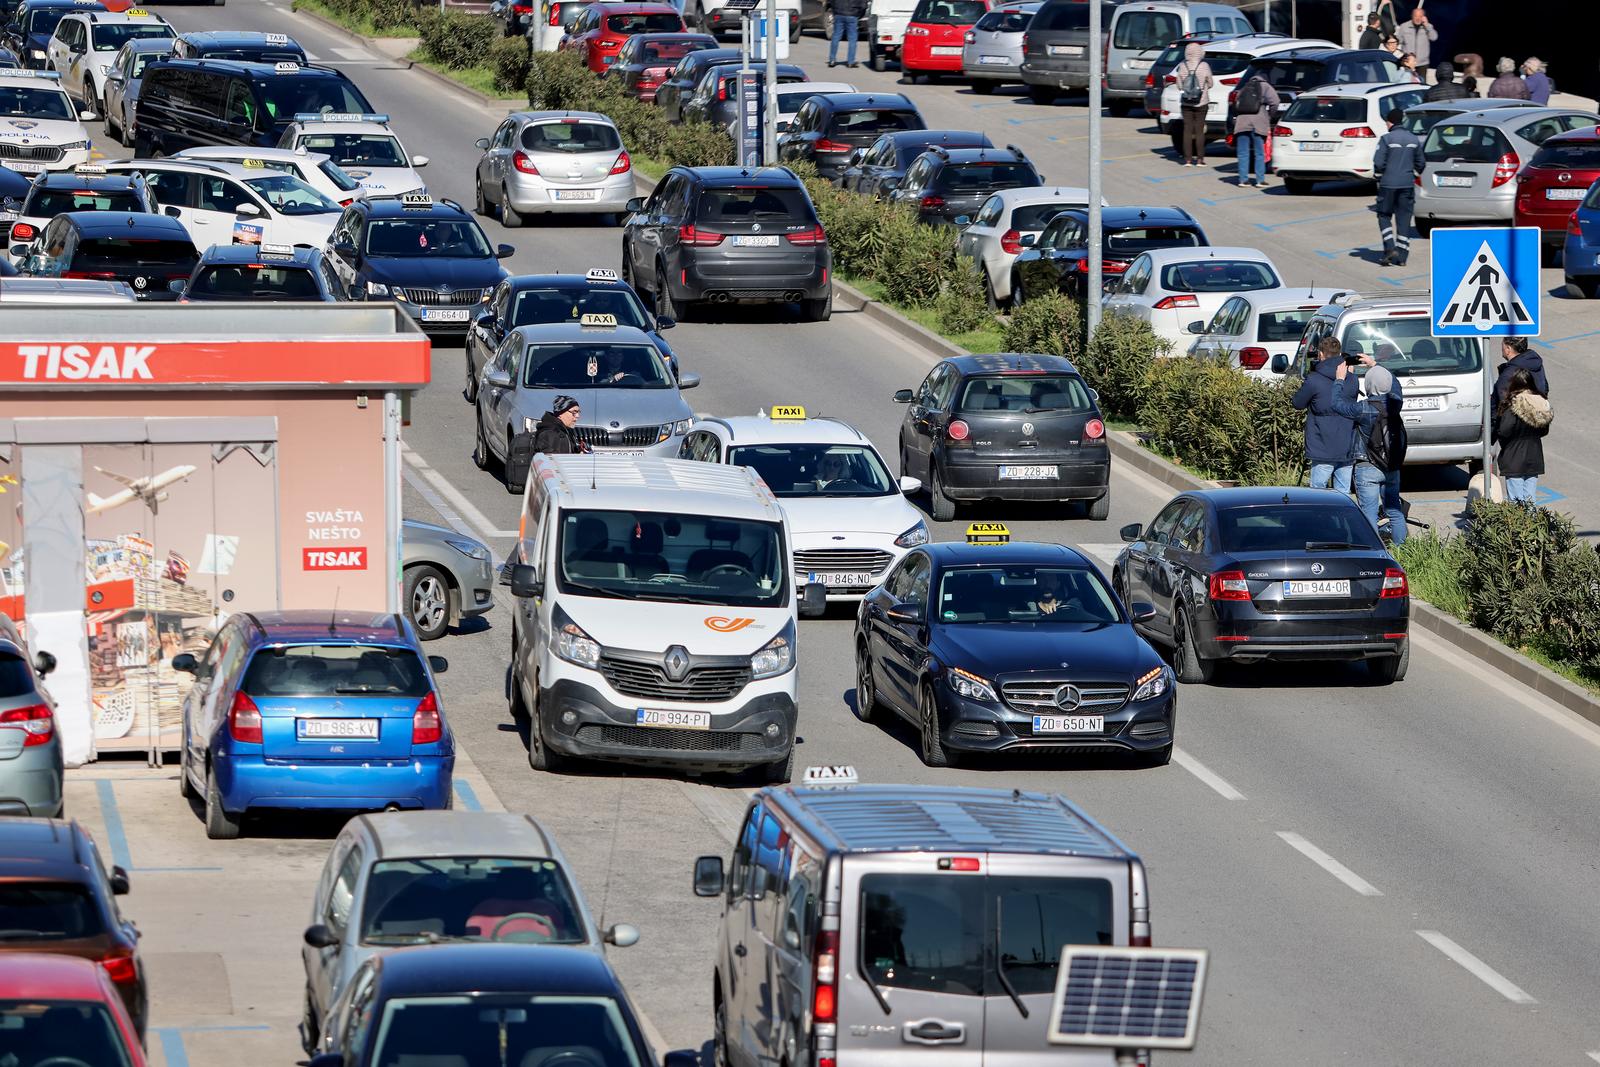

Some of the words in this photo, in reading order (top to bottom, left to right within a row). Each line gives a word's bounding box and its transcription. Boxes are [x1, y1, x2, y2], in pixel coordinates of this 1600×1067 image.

[406, 195, 430, 203] TAXI
[242, 224, 256, 233] TAXI
[586, 315, 613, 324] TAXI
[18, 345, 157, 380] TISAK
[777, 408, 801, 416] TAXI
[305, 507, 364, 524] SVAŠTA
[308, 524, 361, 541] NEŠTO
[974, 523, 1003, 532] TAXI
[306, 551, 363, 567] TISAK
[1291, 583, 1304, 593] ZD
[645, 711, 659, 723] ZD
[307, 723, 322, 735] ZD
[1041, 717, 1055, 730] ZD
[808, 765, 852, 778] TAXI
